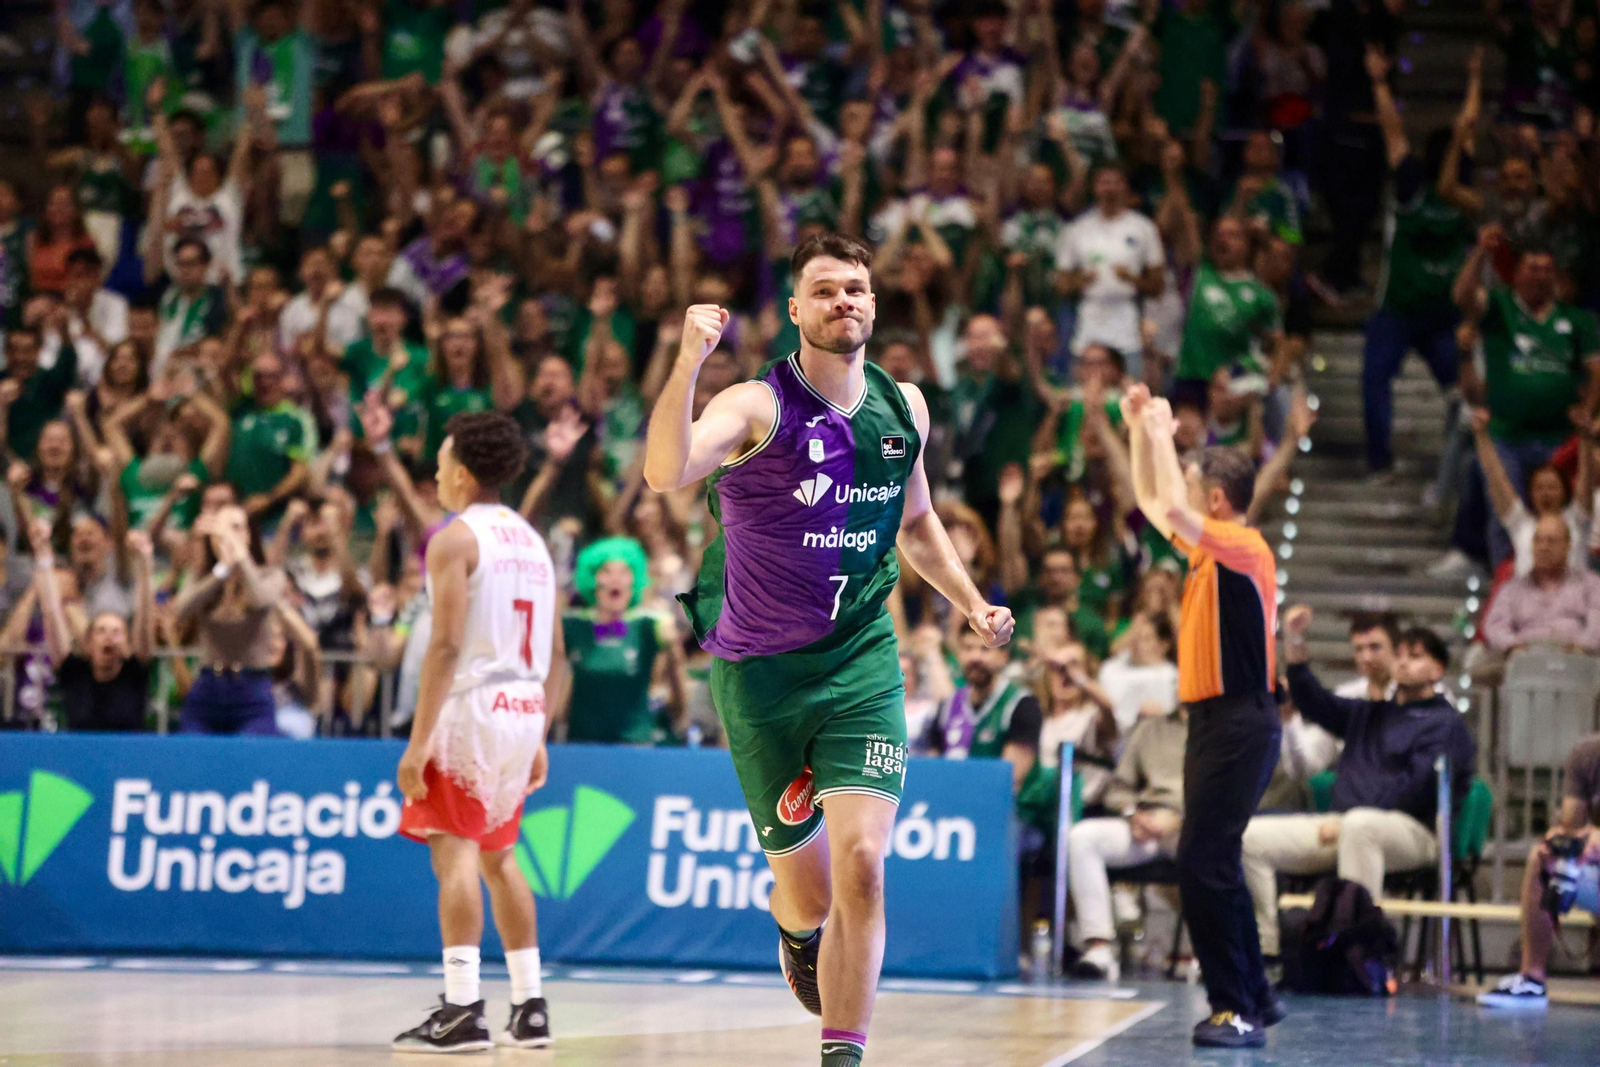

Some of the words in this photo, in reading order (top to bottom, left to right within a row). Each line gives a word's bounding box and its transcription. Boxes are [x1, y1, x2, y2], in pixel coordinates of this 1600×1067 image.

[835, 481, 902, 505] Unicaja
[802, 526, 877, 552] málaga
[828, 575, 849, 621] 7
[866, 733, 888, 742] sabor
[110, 778, 401, 838] Fundació
[107, 835, 346, 910] Unicaja
[646, 852, 775, 912] Unic
